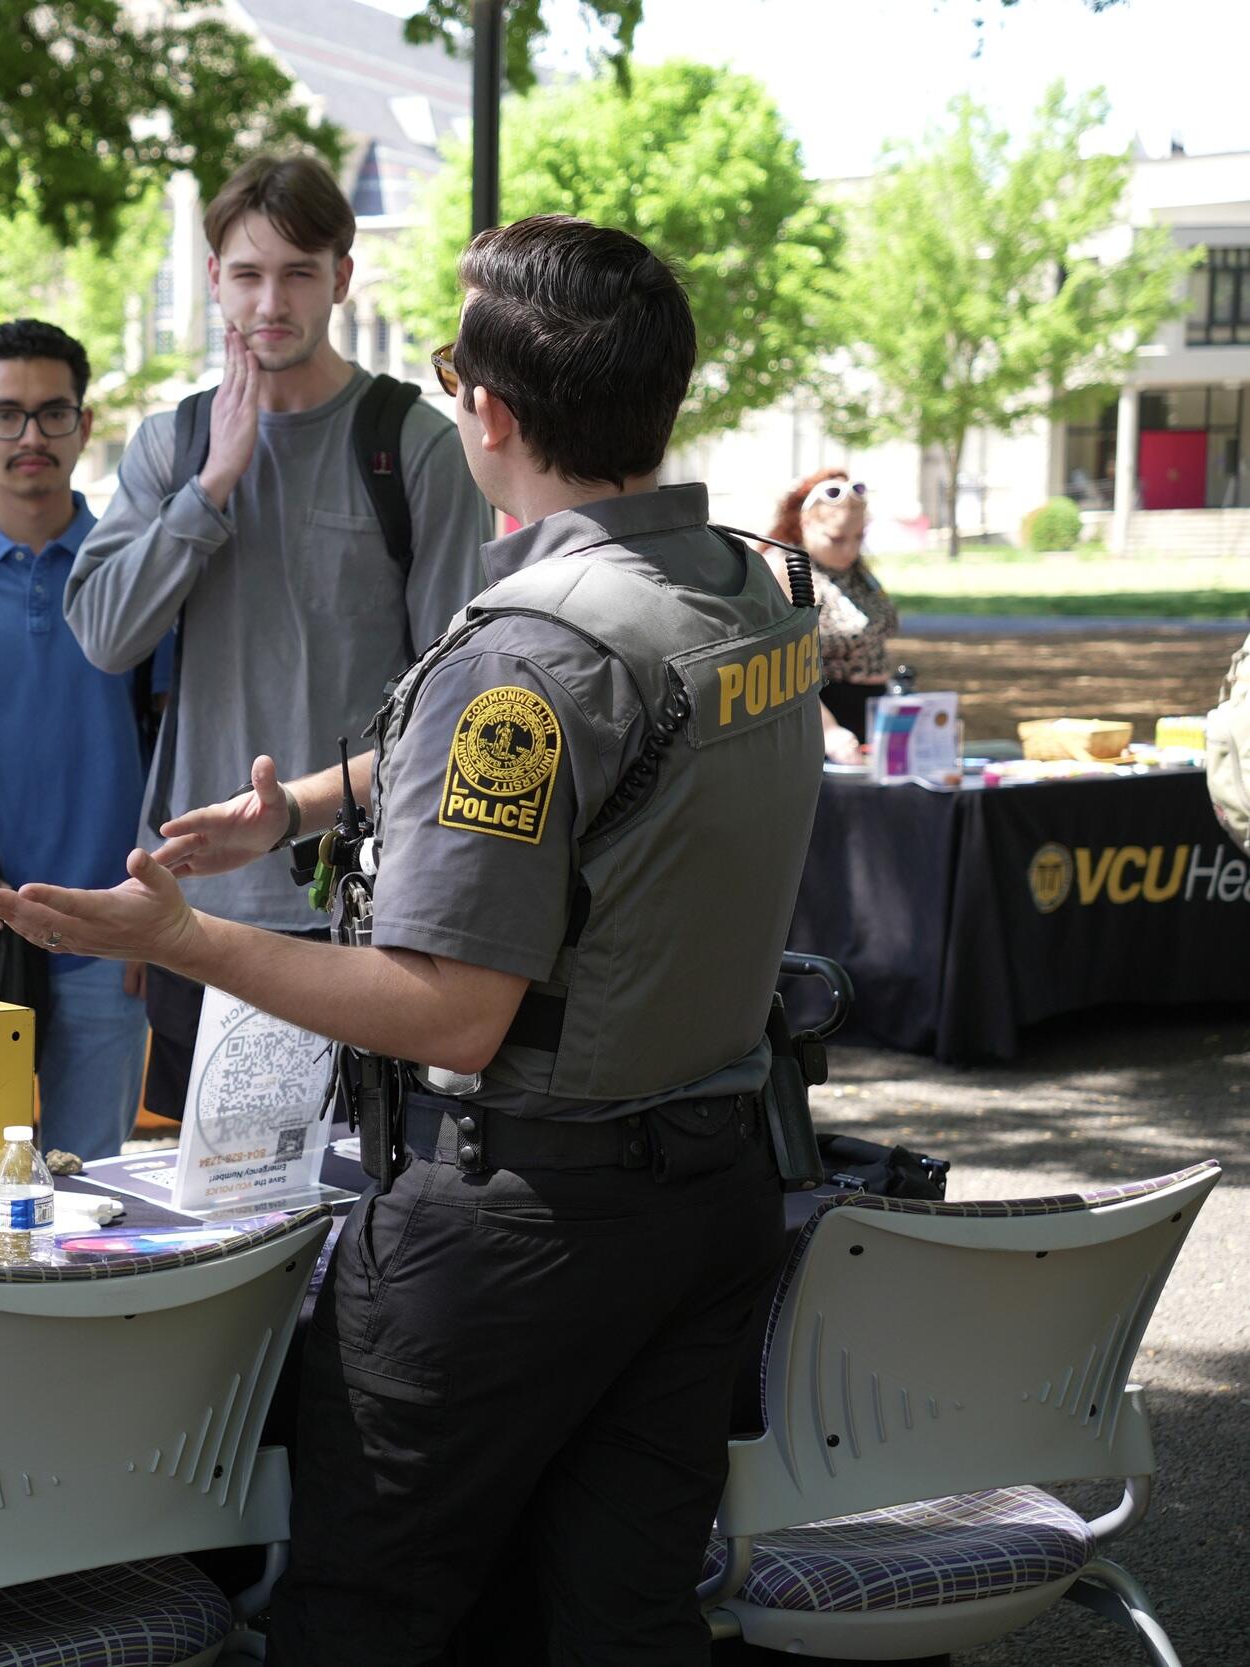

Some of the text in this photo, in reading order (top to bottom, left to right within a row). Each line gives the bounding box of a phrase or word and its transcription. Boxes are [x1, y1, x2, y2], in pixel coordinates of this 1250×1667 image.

[717, 625, 820, 726] POLICE
[466, 690, 556, 735] COMMONWEALTH
[487, 714, 529, 732] VIRGINIA
[458, 731, 480, 784] VIRGINIA
[490, 748, 556, 793] UNIVERSITY
[447, 795, 538, 833] POLICE
[1074, 844, 1189, 905] VCU
[208, 1163, 287, 1184] Emergency Number!
[253, 1178, 268, 1187] the
[268, 1175, 287, 1184] Save
